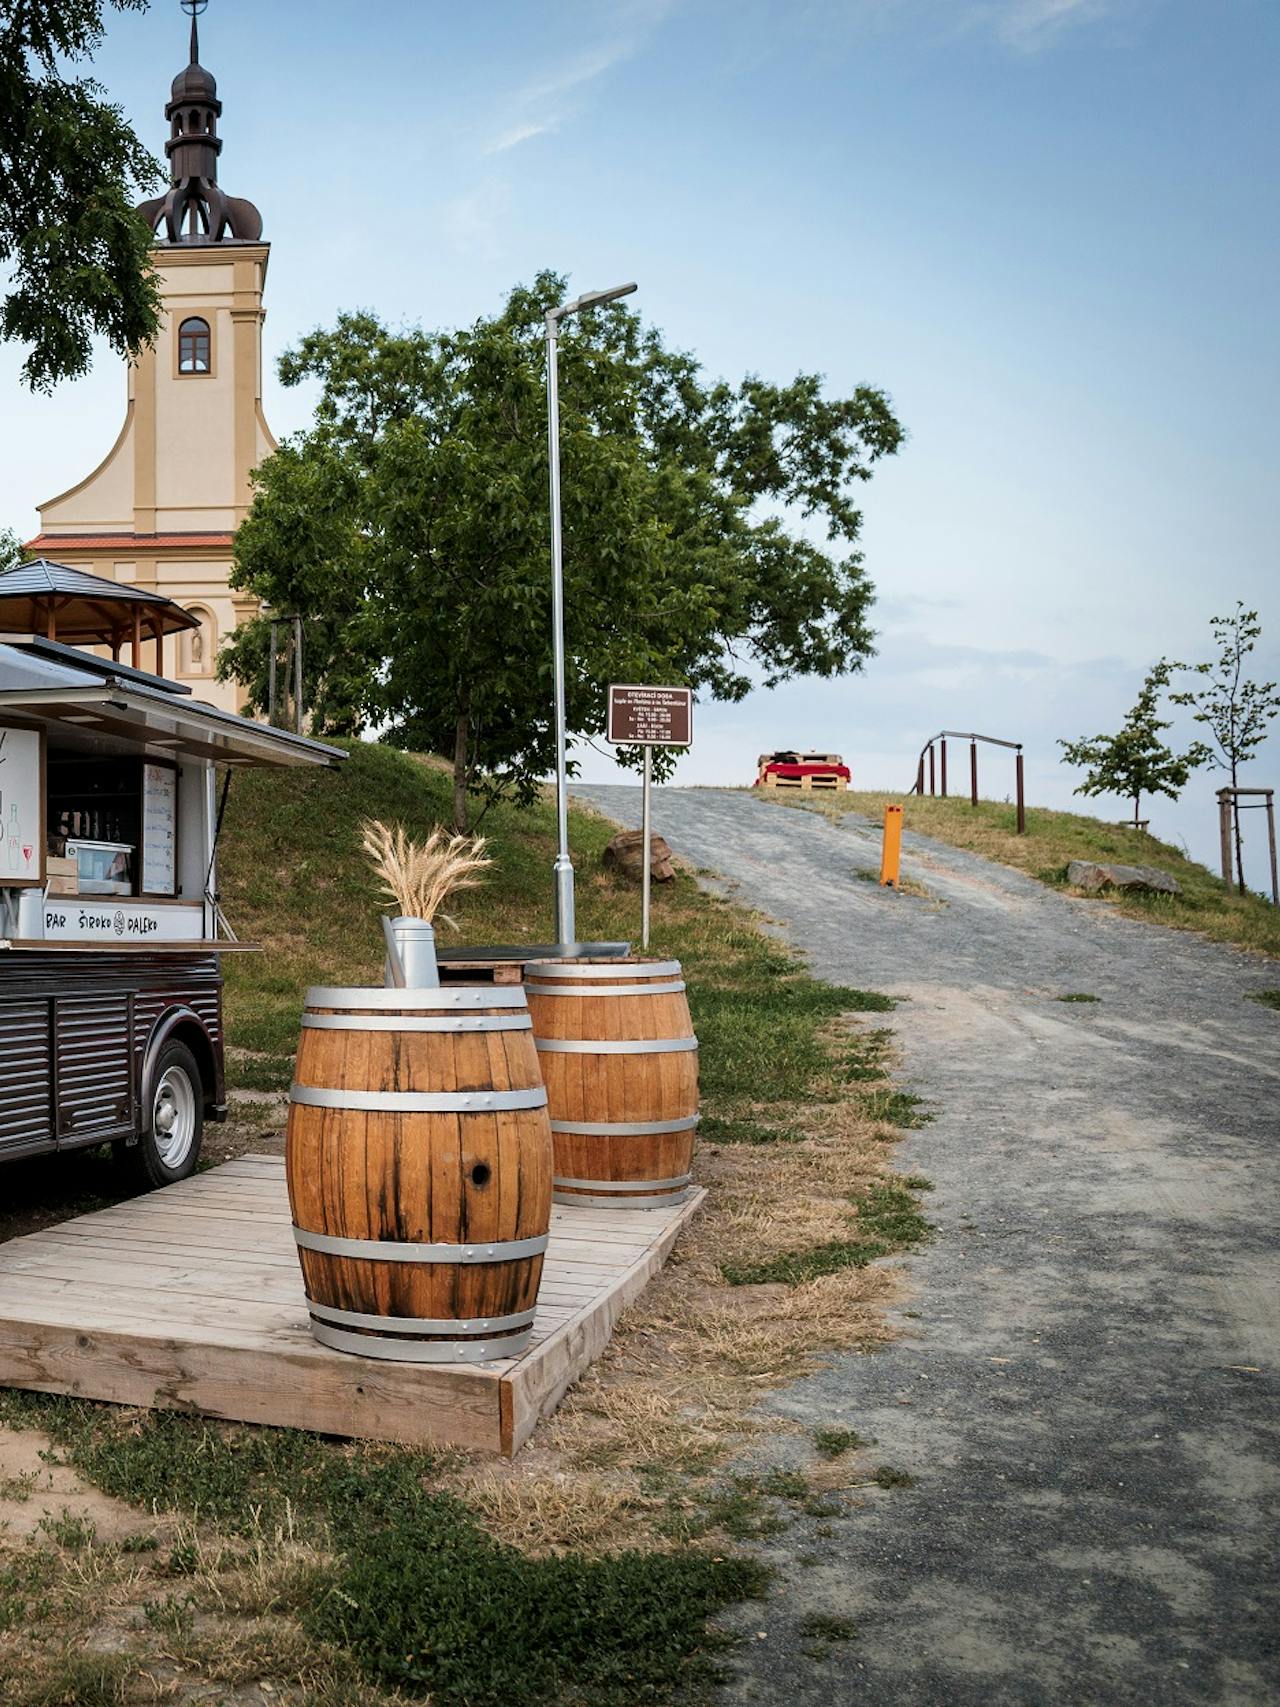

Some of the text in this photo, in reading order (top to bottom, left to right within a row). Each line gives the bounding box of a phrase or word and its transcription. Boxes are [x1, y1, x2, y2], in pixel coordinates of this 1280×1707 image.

[46, 909, 158, 934] BAR ŠIROKO DALEKO
